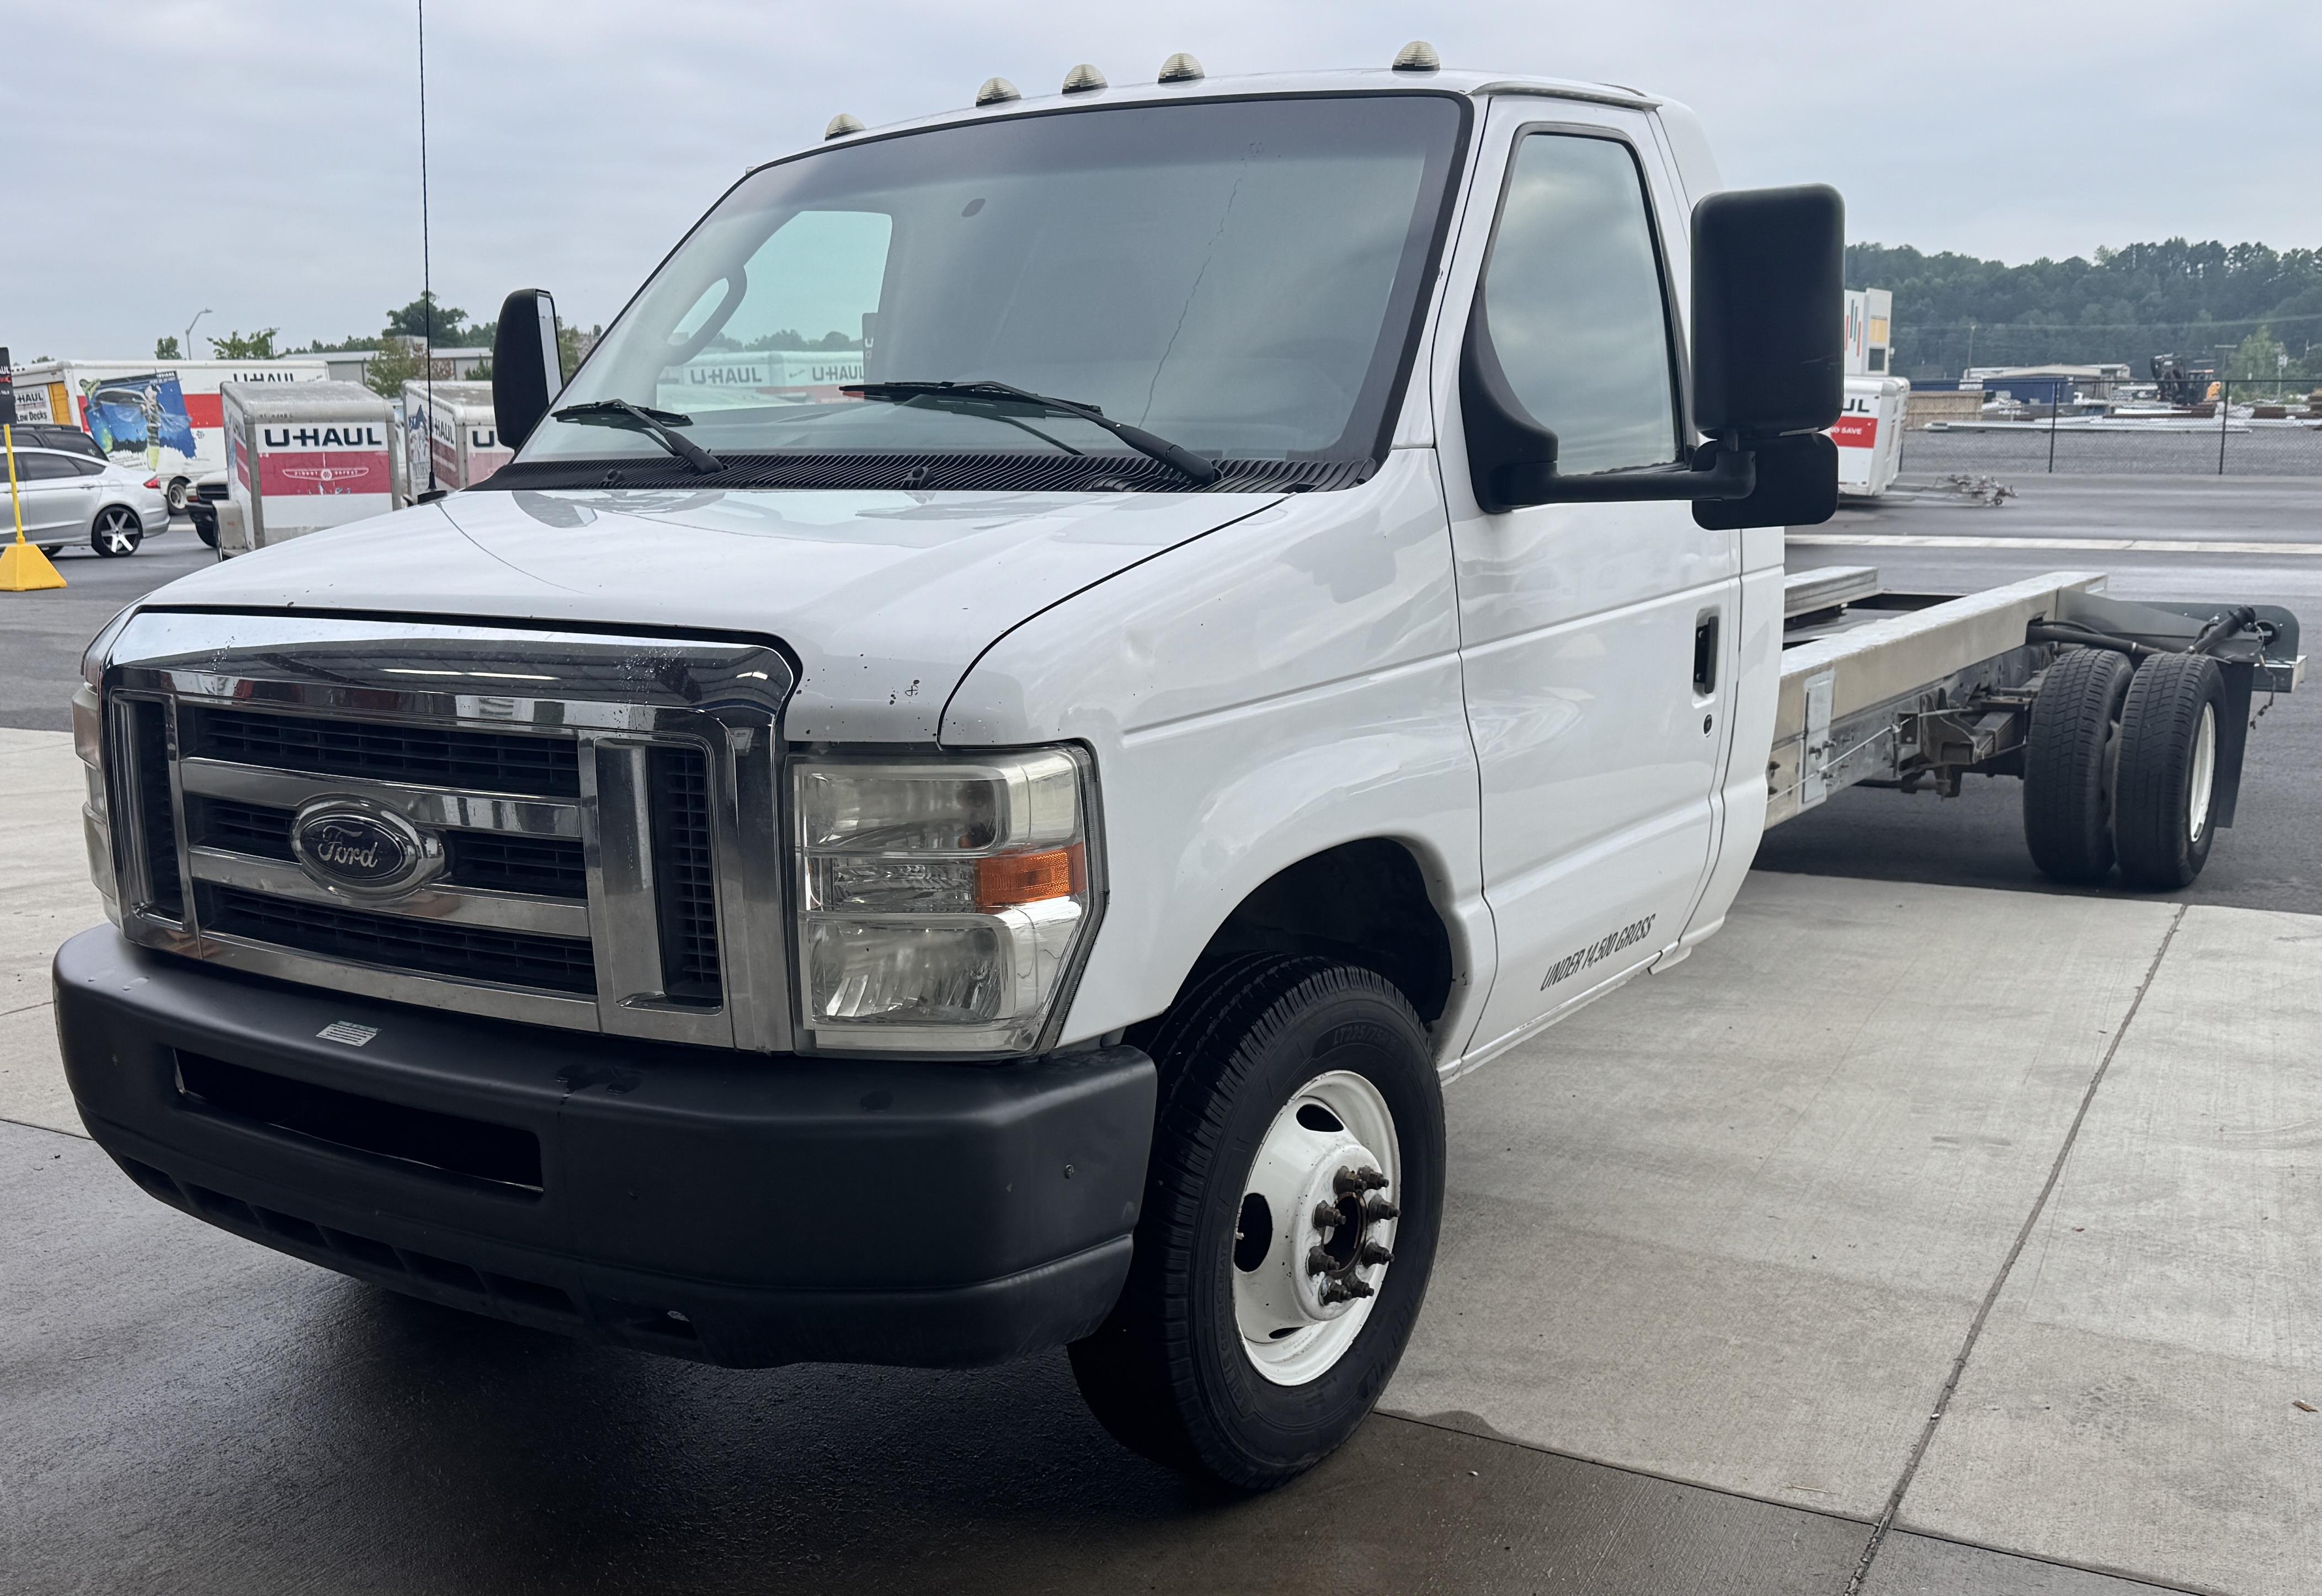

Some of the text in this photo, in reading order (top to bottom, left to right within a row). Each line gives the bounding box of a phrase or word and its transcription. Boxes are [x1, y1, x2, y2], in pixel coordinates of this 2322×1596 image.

[690, 367, 762, 385] U-HAUL
[264, 428, 382, 447] U-HAUL
[1841, 426, 1862, 435] SAVE
[318, 825, 378, 868] Ford
[1540, 913, 1656, 991] UNDER 14,500 GROSS
